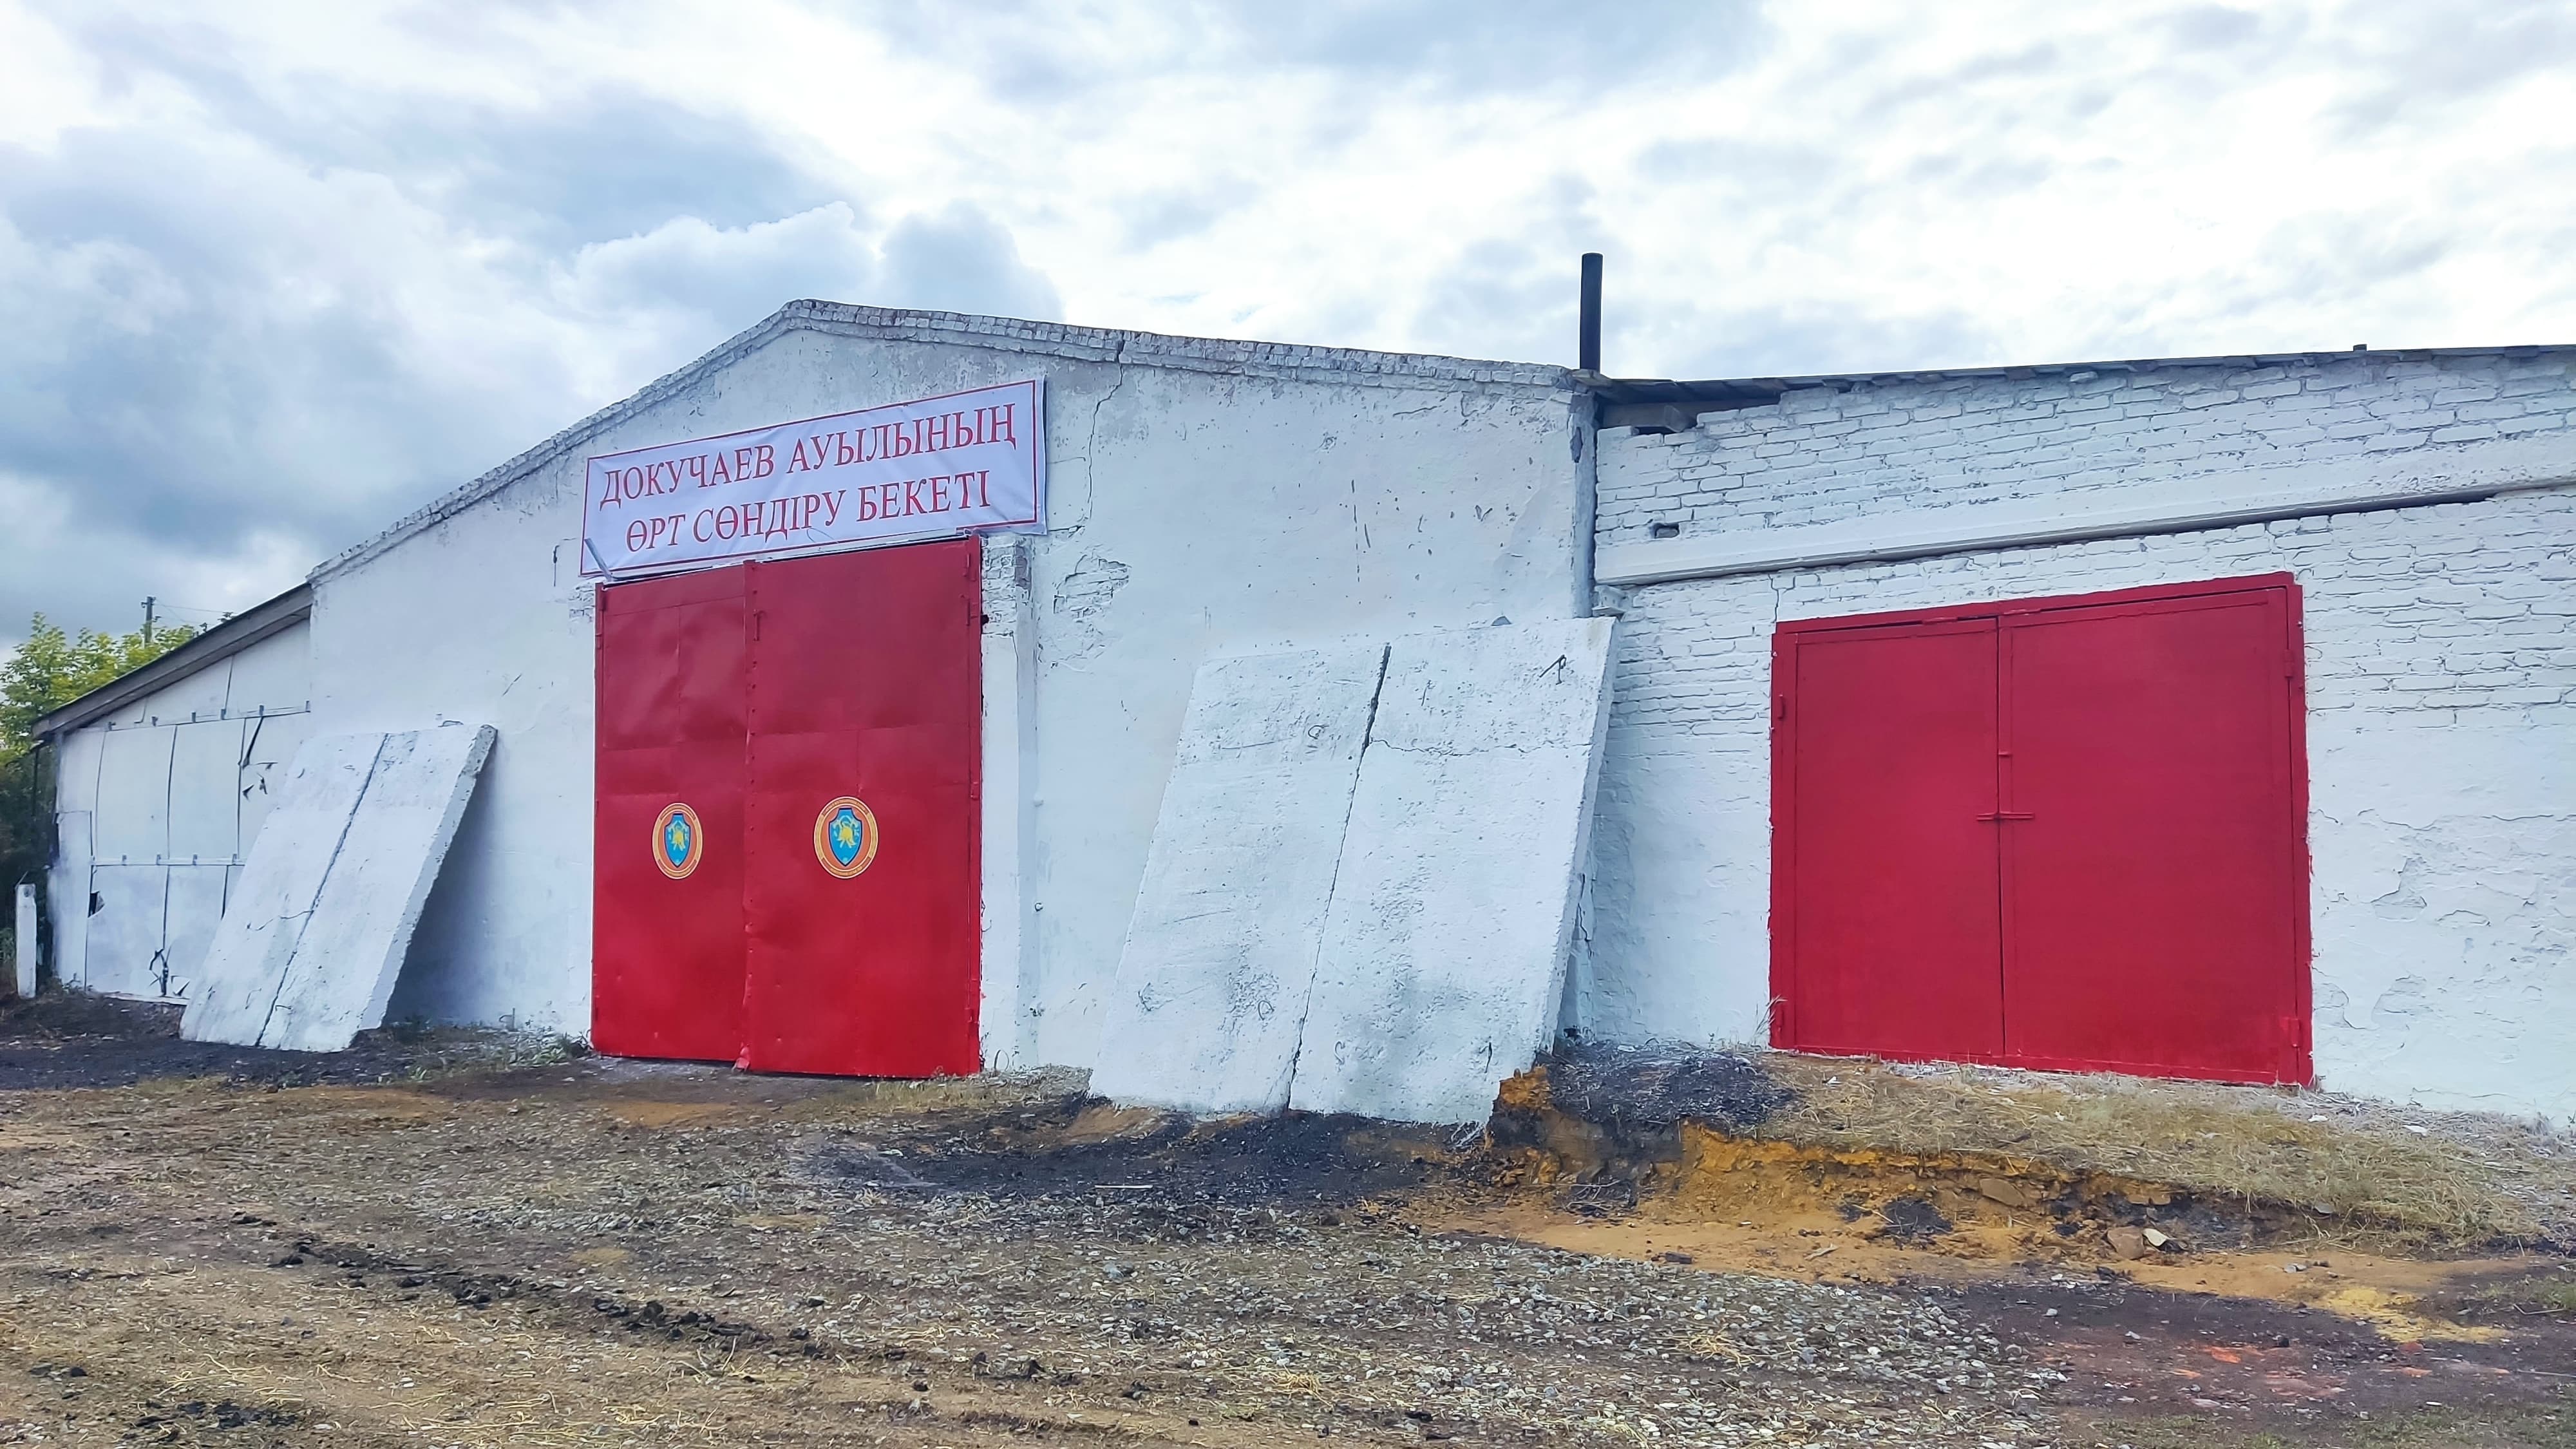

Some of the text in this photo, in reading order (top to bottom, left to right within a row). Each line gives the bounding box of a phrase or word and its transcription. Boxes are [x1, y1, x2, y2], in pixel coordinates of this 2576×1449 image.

[600, 403, 1016, 511] ДОКУЧАЕВ АУЫЛЫНЫҢ
[626, 471, 990, 552] ӨРТ СӨНДІРУ БЕКЕТІ
